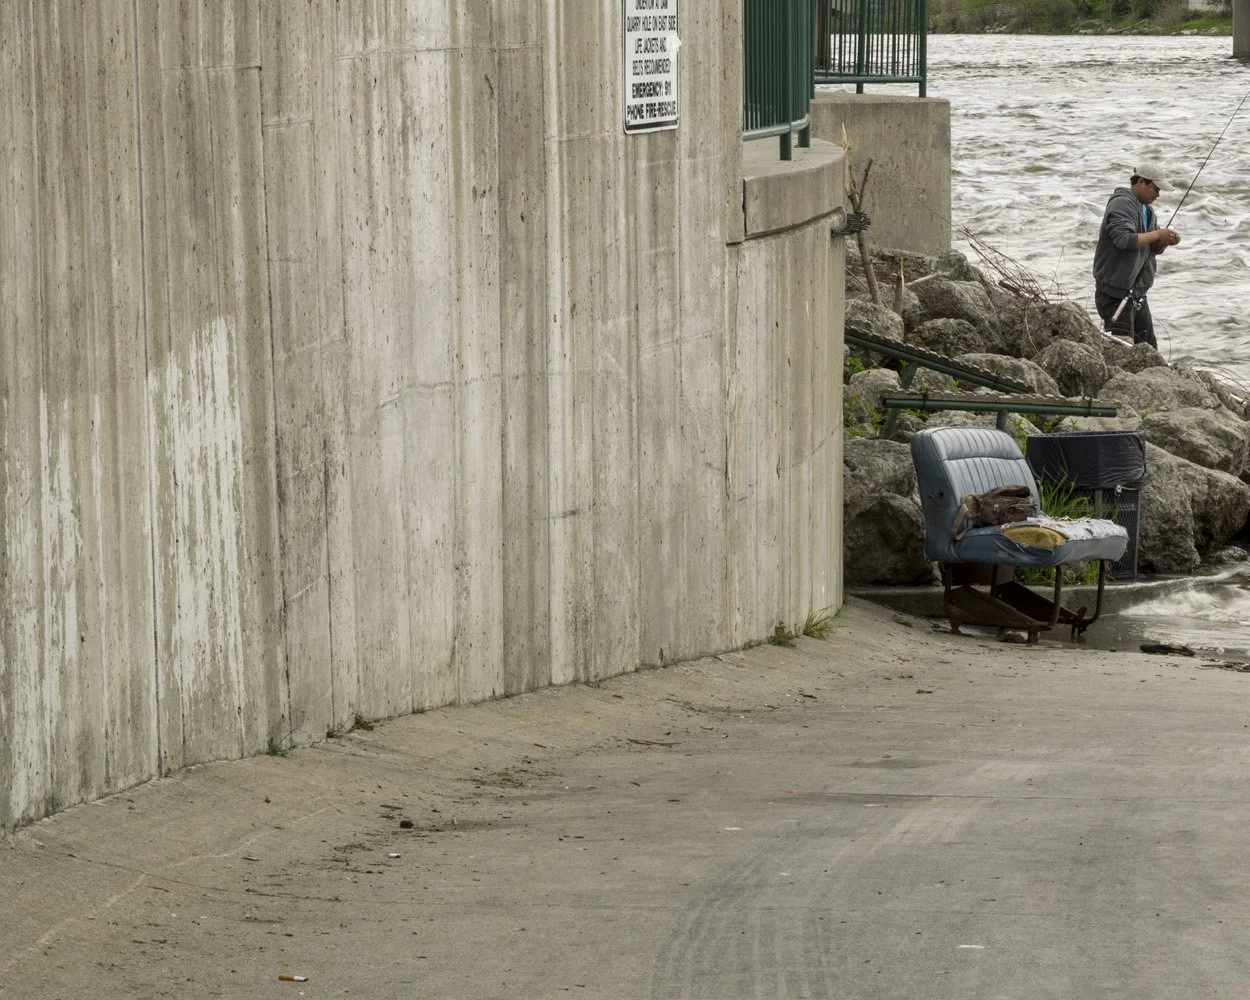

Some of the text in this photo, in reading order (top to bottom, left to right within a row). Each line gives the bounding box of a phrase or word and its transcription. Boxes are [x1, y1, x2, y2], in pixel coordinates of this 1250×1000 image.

[626, 15, 676, 32] QUARRY HOLE ON EAST SIDE
[634, 38, 643, 54] LIFE
[643, 37, 658, 53] JACKETS
[632, 58, 671, 76] BELTS RECOMMENDED
[664, 80, 672, 96] 911
[626, 100, 676, 120] PHONE FIRE-RESCUE
